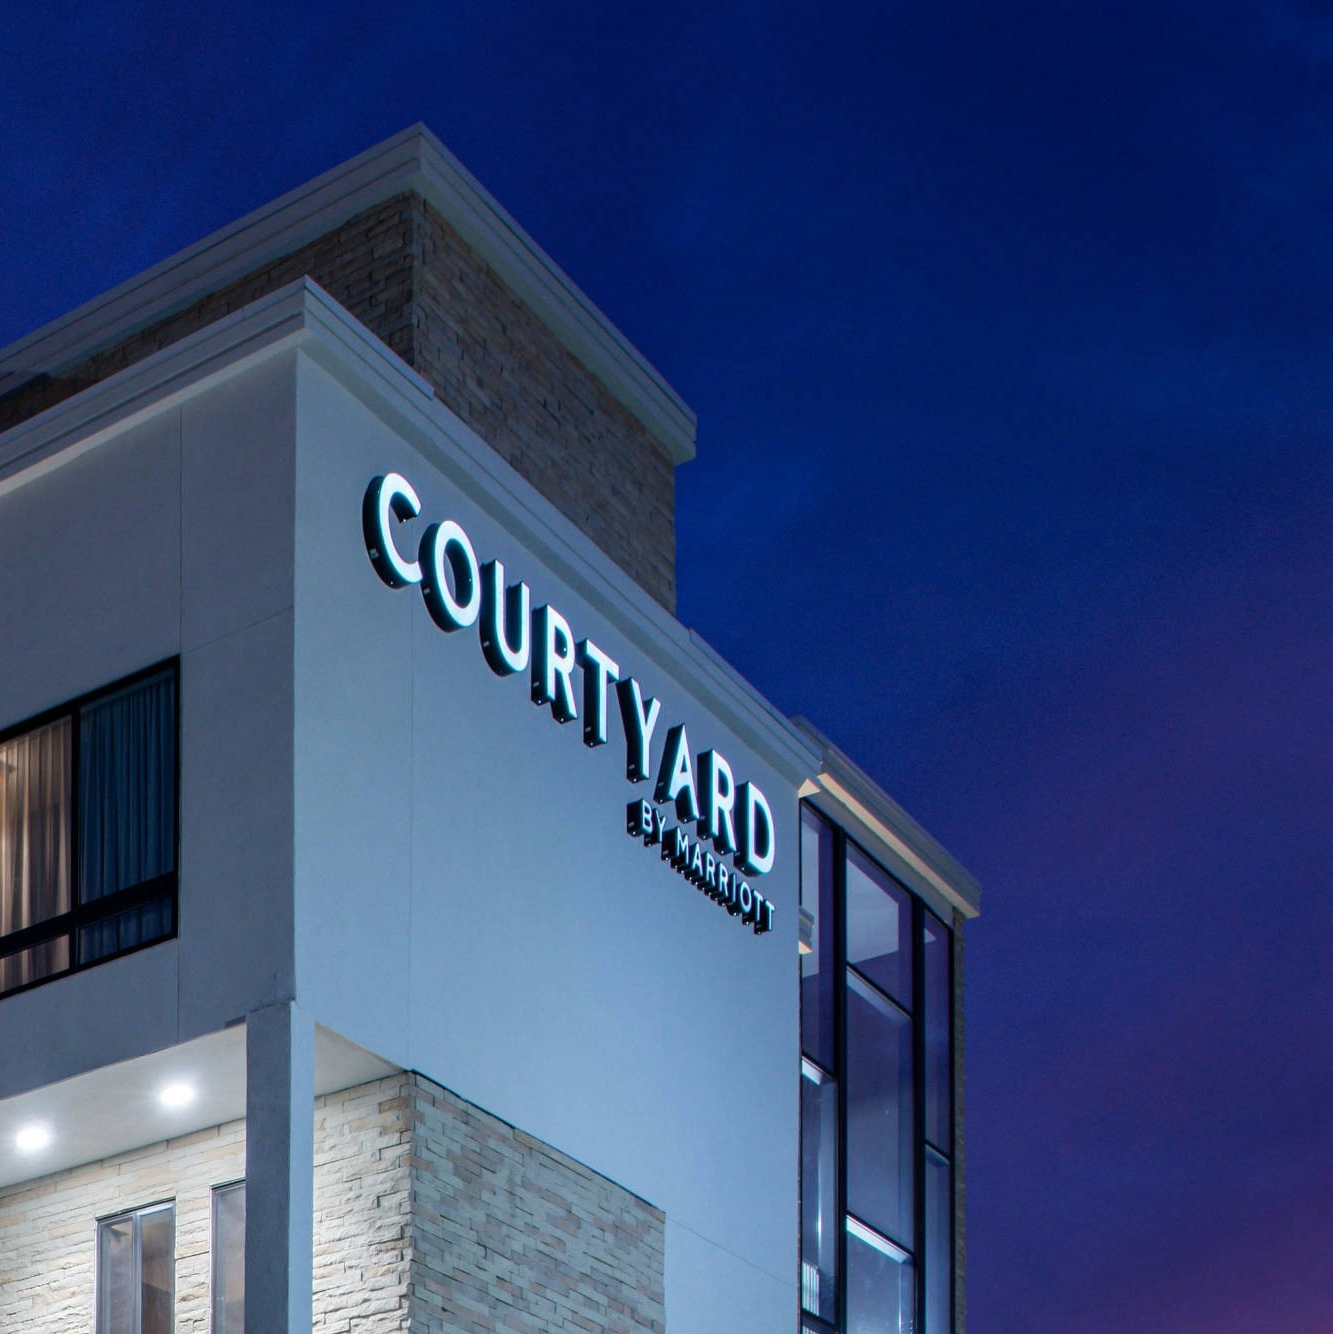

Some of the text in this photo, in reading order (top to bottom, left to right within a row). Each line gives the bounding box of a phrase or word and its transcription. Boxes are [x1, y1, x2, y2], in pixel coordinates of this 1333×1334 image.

[363, 473, 775, 877] COURTYARD
[633, 799, 775, 934] BY MARRIOTT
